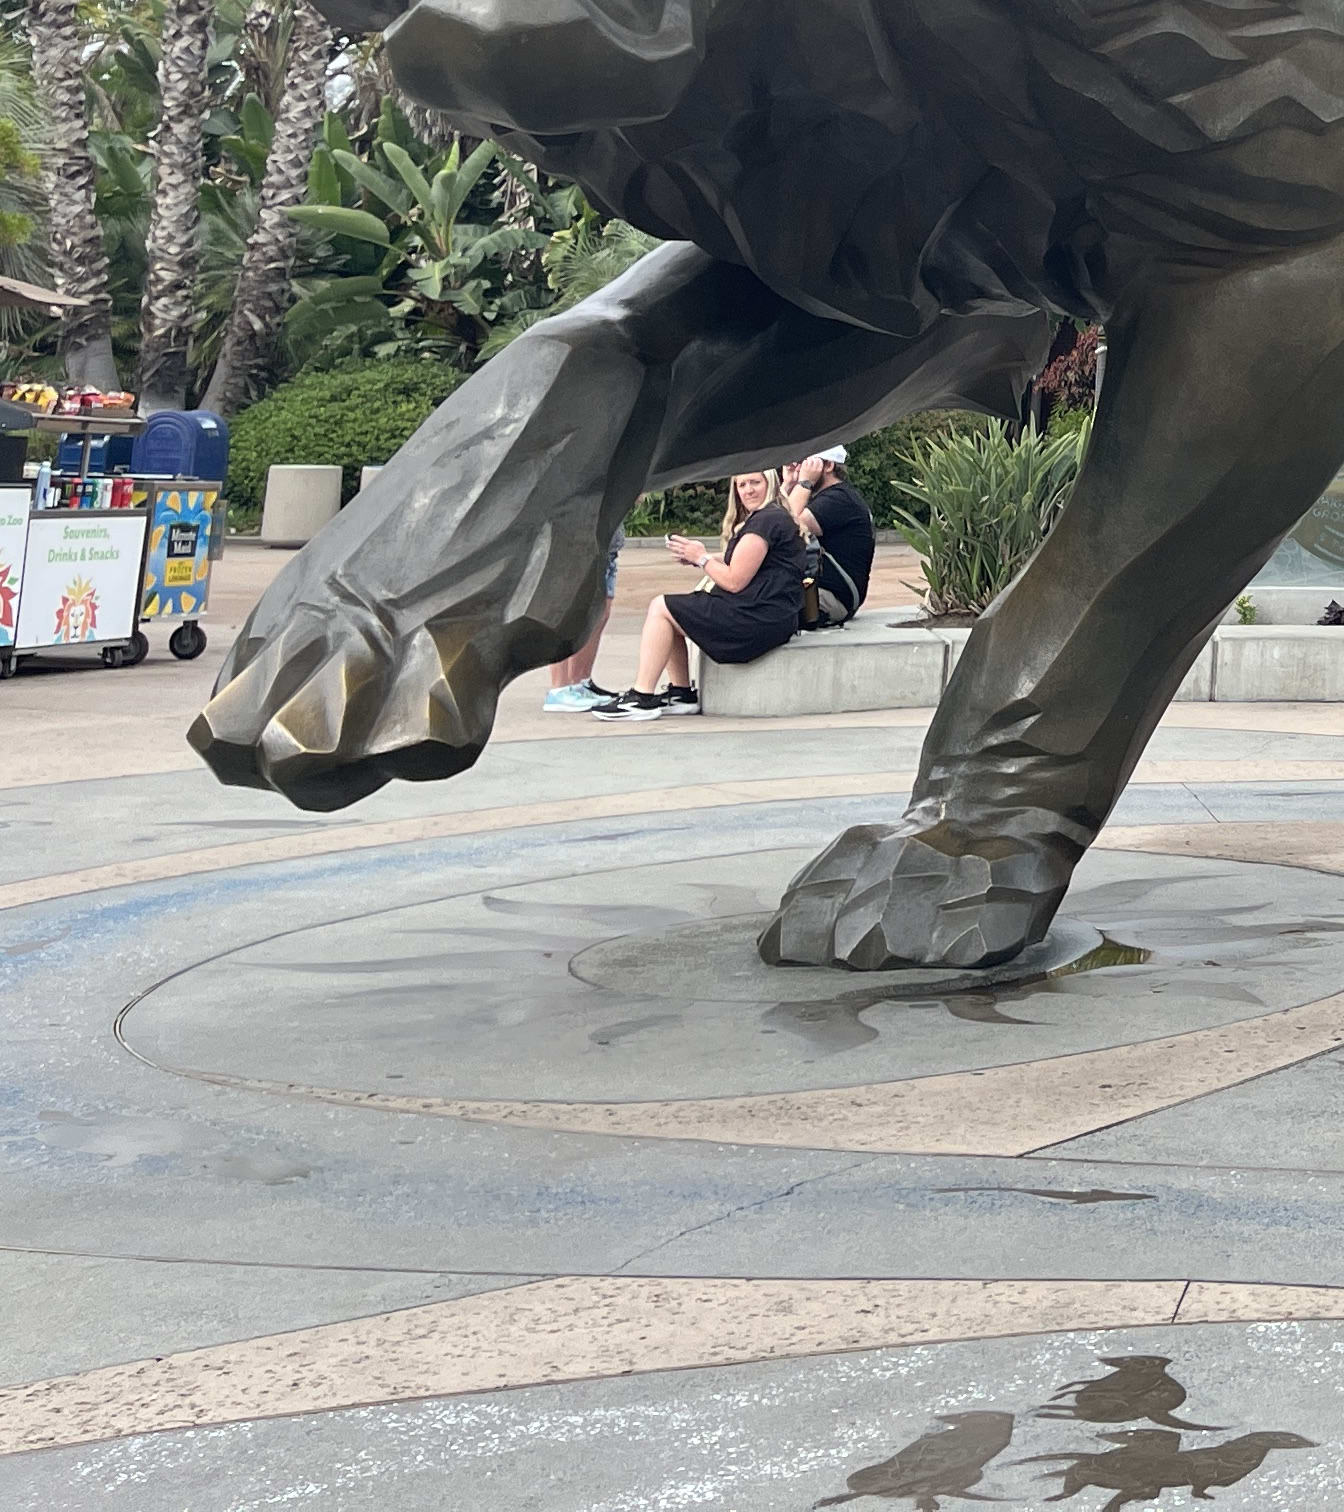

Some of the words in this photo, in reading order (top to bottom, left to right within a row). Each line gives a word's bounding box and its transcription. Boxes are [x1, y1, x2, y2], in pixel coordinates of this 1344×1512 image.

[7, 514, 23, 526] Zoo
[63, 525, 110, 540] Souvenirs,
[48, 548, 77, 563] Drinks
[79, 548, 87, 561] &
[88, 547, 119, 561] Snacks
